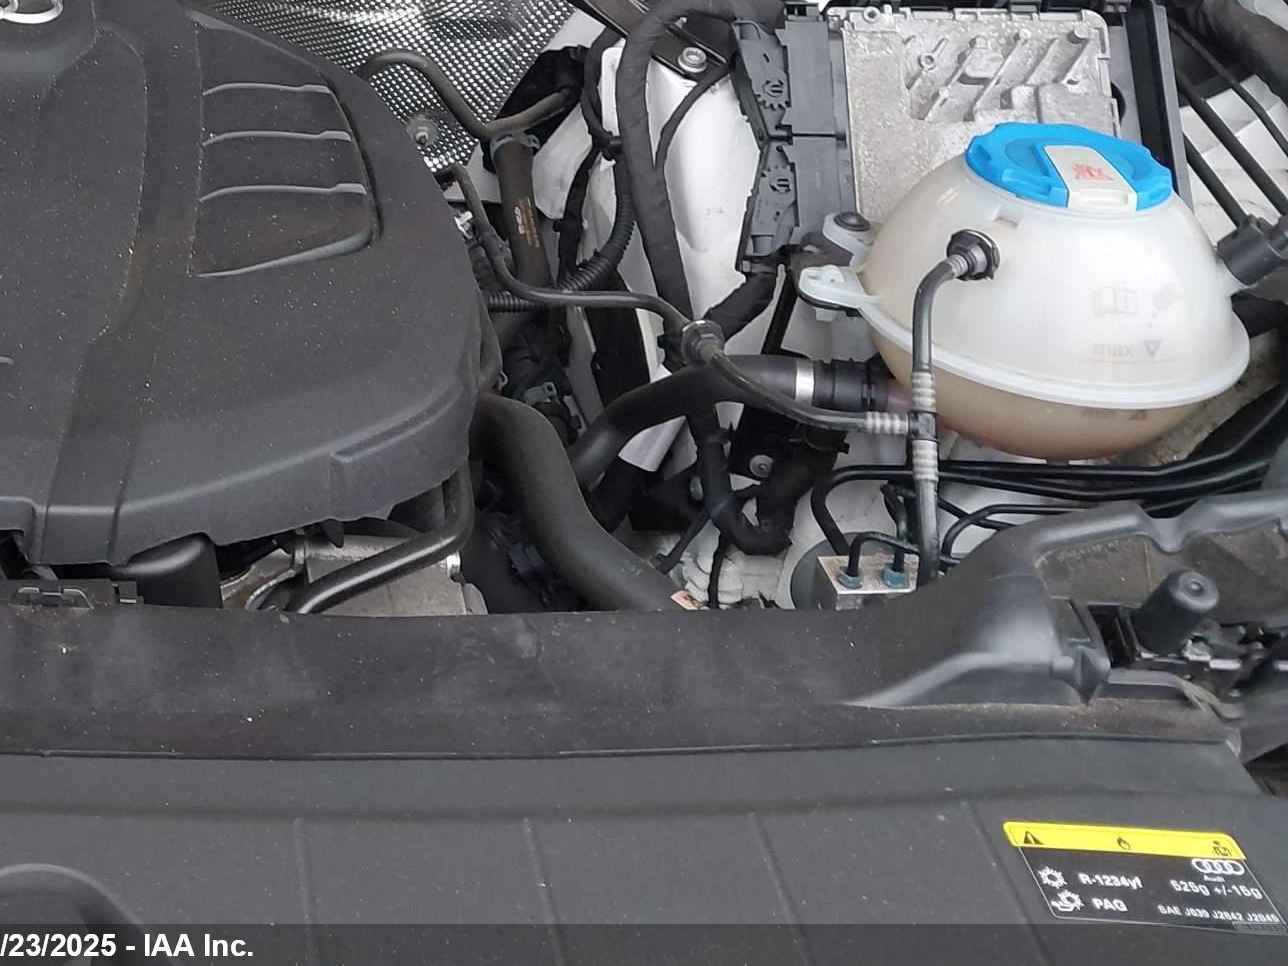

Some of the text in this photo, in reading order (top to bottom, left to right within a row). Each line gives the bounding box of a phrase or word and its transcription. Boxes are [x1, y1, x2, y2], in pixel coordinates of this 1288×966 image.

[1094, 344, 1134, 356] max
[1077, 873, 1143, 890] R-1234yf
[1203, 874, 1226, 883] Audi
[1092, 897, 1129, 912] PAG
[1157, 905, 1184, 916] SAE
